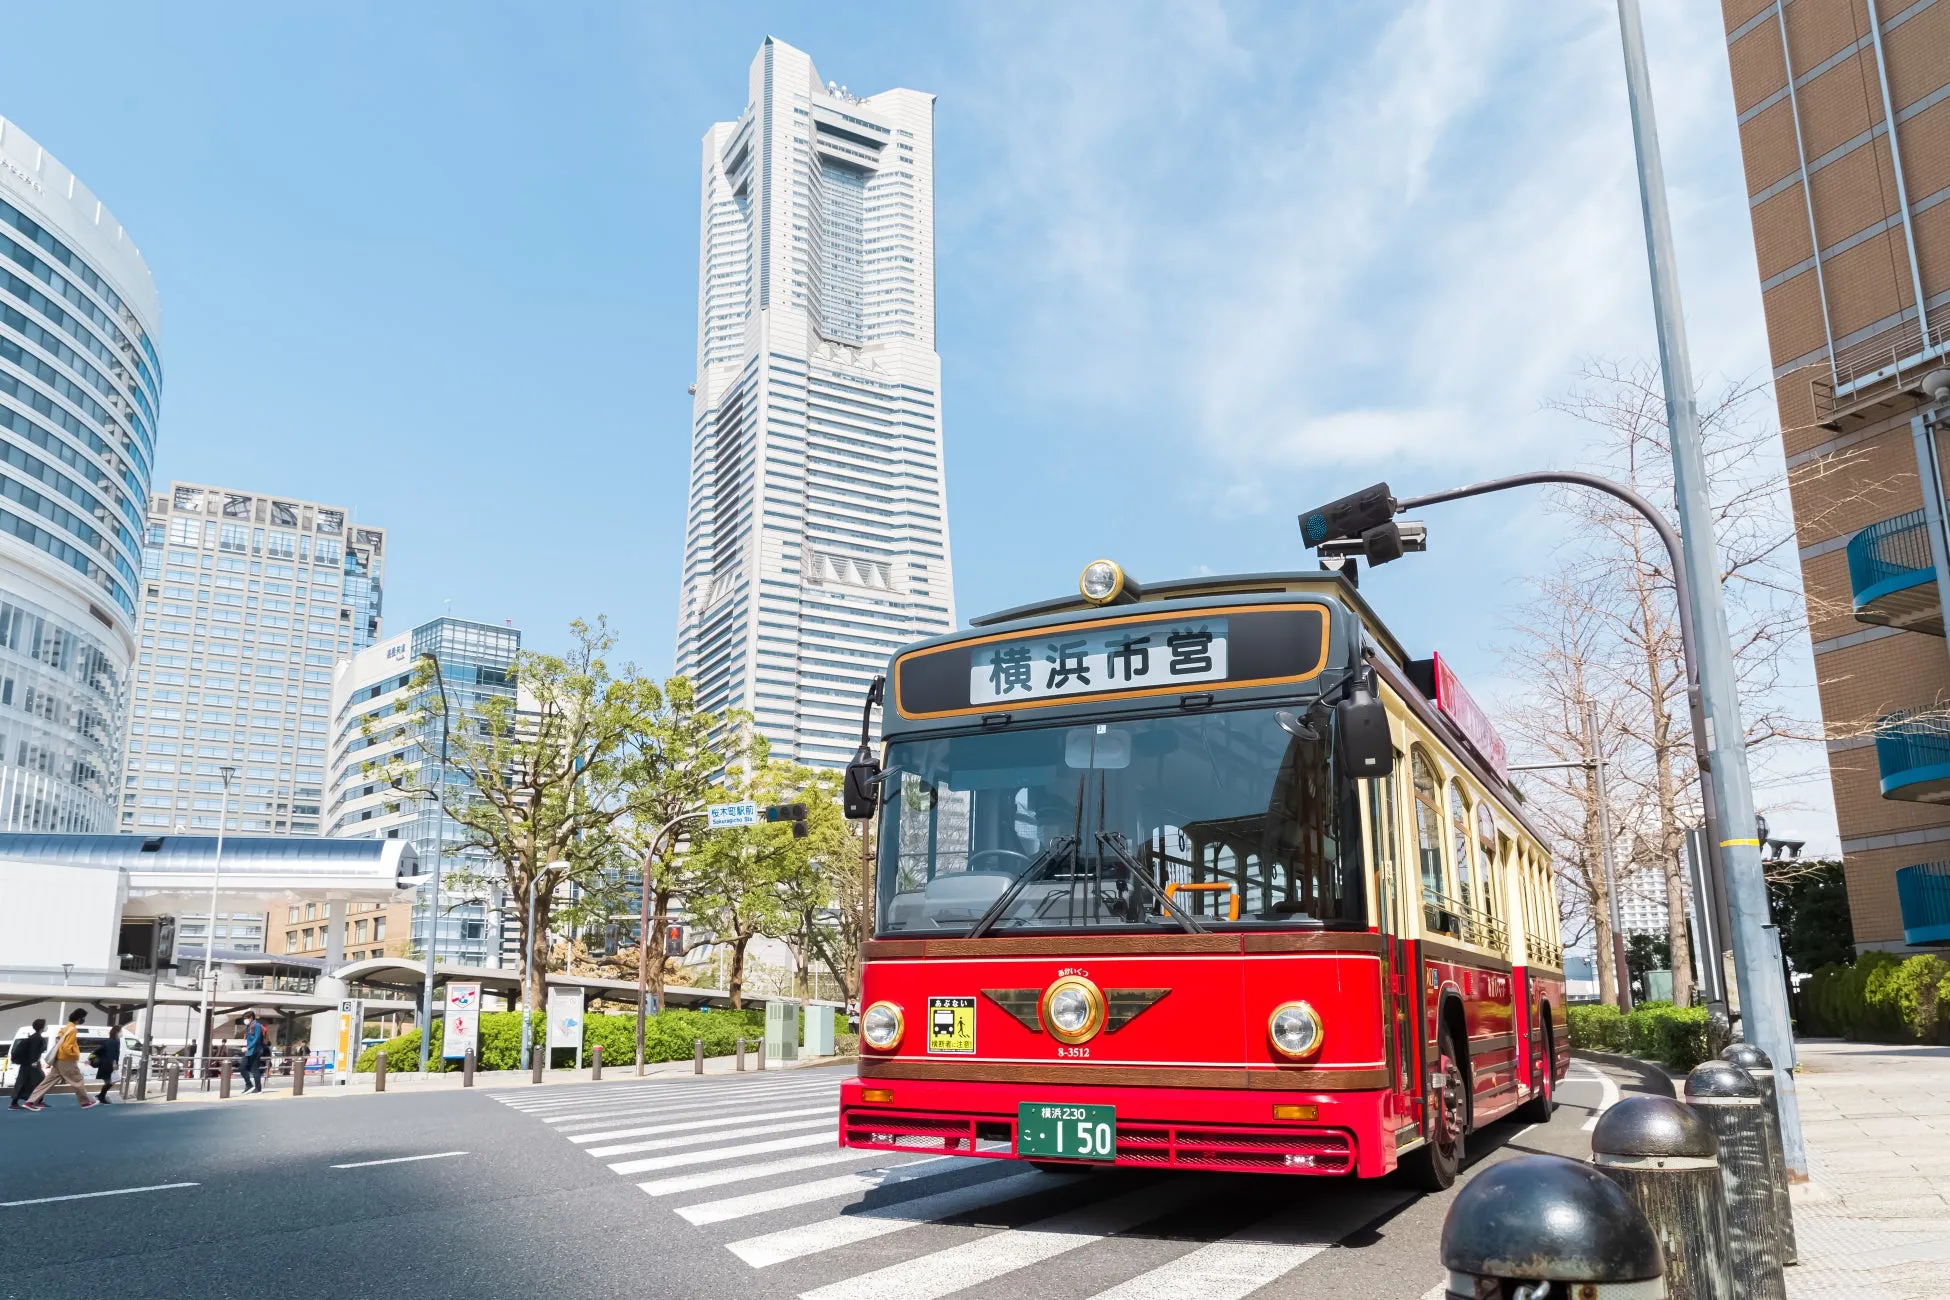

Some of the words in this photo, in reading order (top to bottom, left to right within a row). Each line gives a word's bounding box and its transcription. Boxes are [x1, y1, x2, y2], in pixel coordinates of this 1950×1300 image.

[988, 624, 1213, 695] 横浜市営
[712, 805, 753, 817] 桜木町駅前
[1058, 967, 1089, 977] あかいくつ
[344, 1002, 351, 1011] 6
[935, 999, 968, 1008] あぶない
[1058, 1047, 1090, 1058] 8-3512
